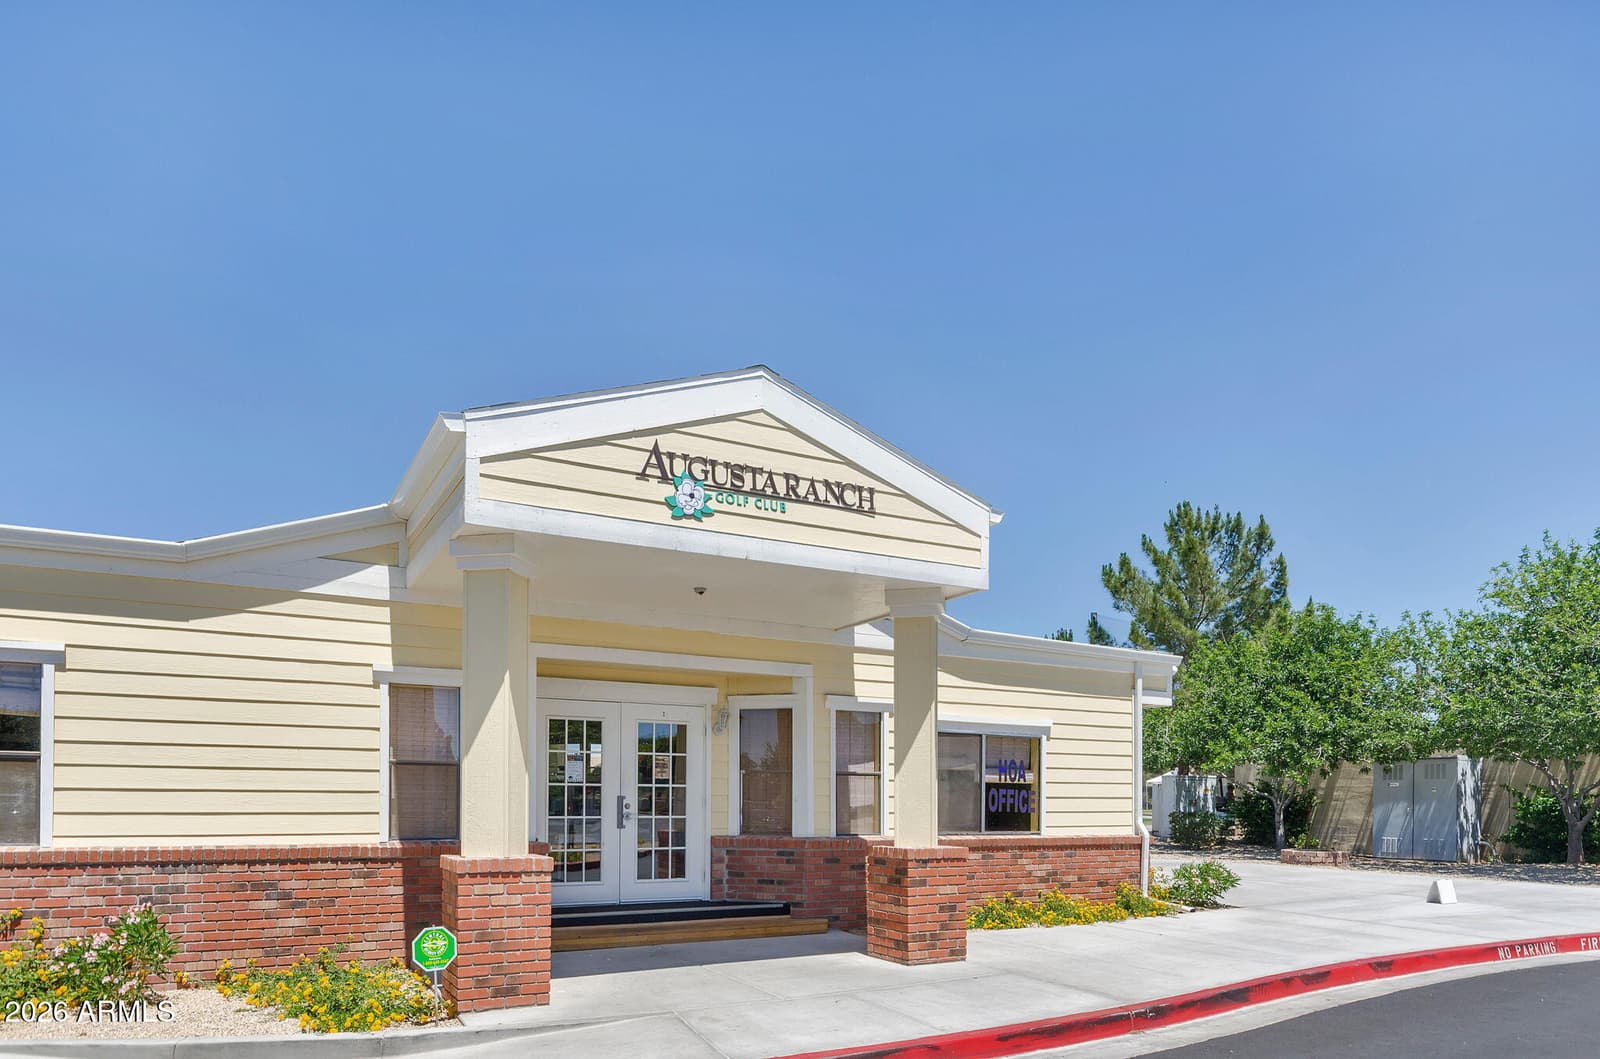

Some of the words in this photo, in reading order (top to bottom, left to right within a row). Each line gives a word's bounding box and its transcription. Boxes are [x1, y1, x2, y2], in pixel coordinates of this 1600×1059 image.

[634, 438, 780, 497] AUGUSTA
[783, 472, 876, 511] RANCH
[715, 491, 749, 508] GOLF
[754, 497, 787, 514] CLUB
[998, 759, 1027, 782] HOA
[988, 787, 1036, 813] OFFICE
[1497, 946, 1512, 961] NO
[1515, 942, 1556, 958] PARKING
[1580, 937, 1600, 951] FIR
